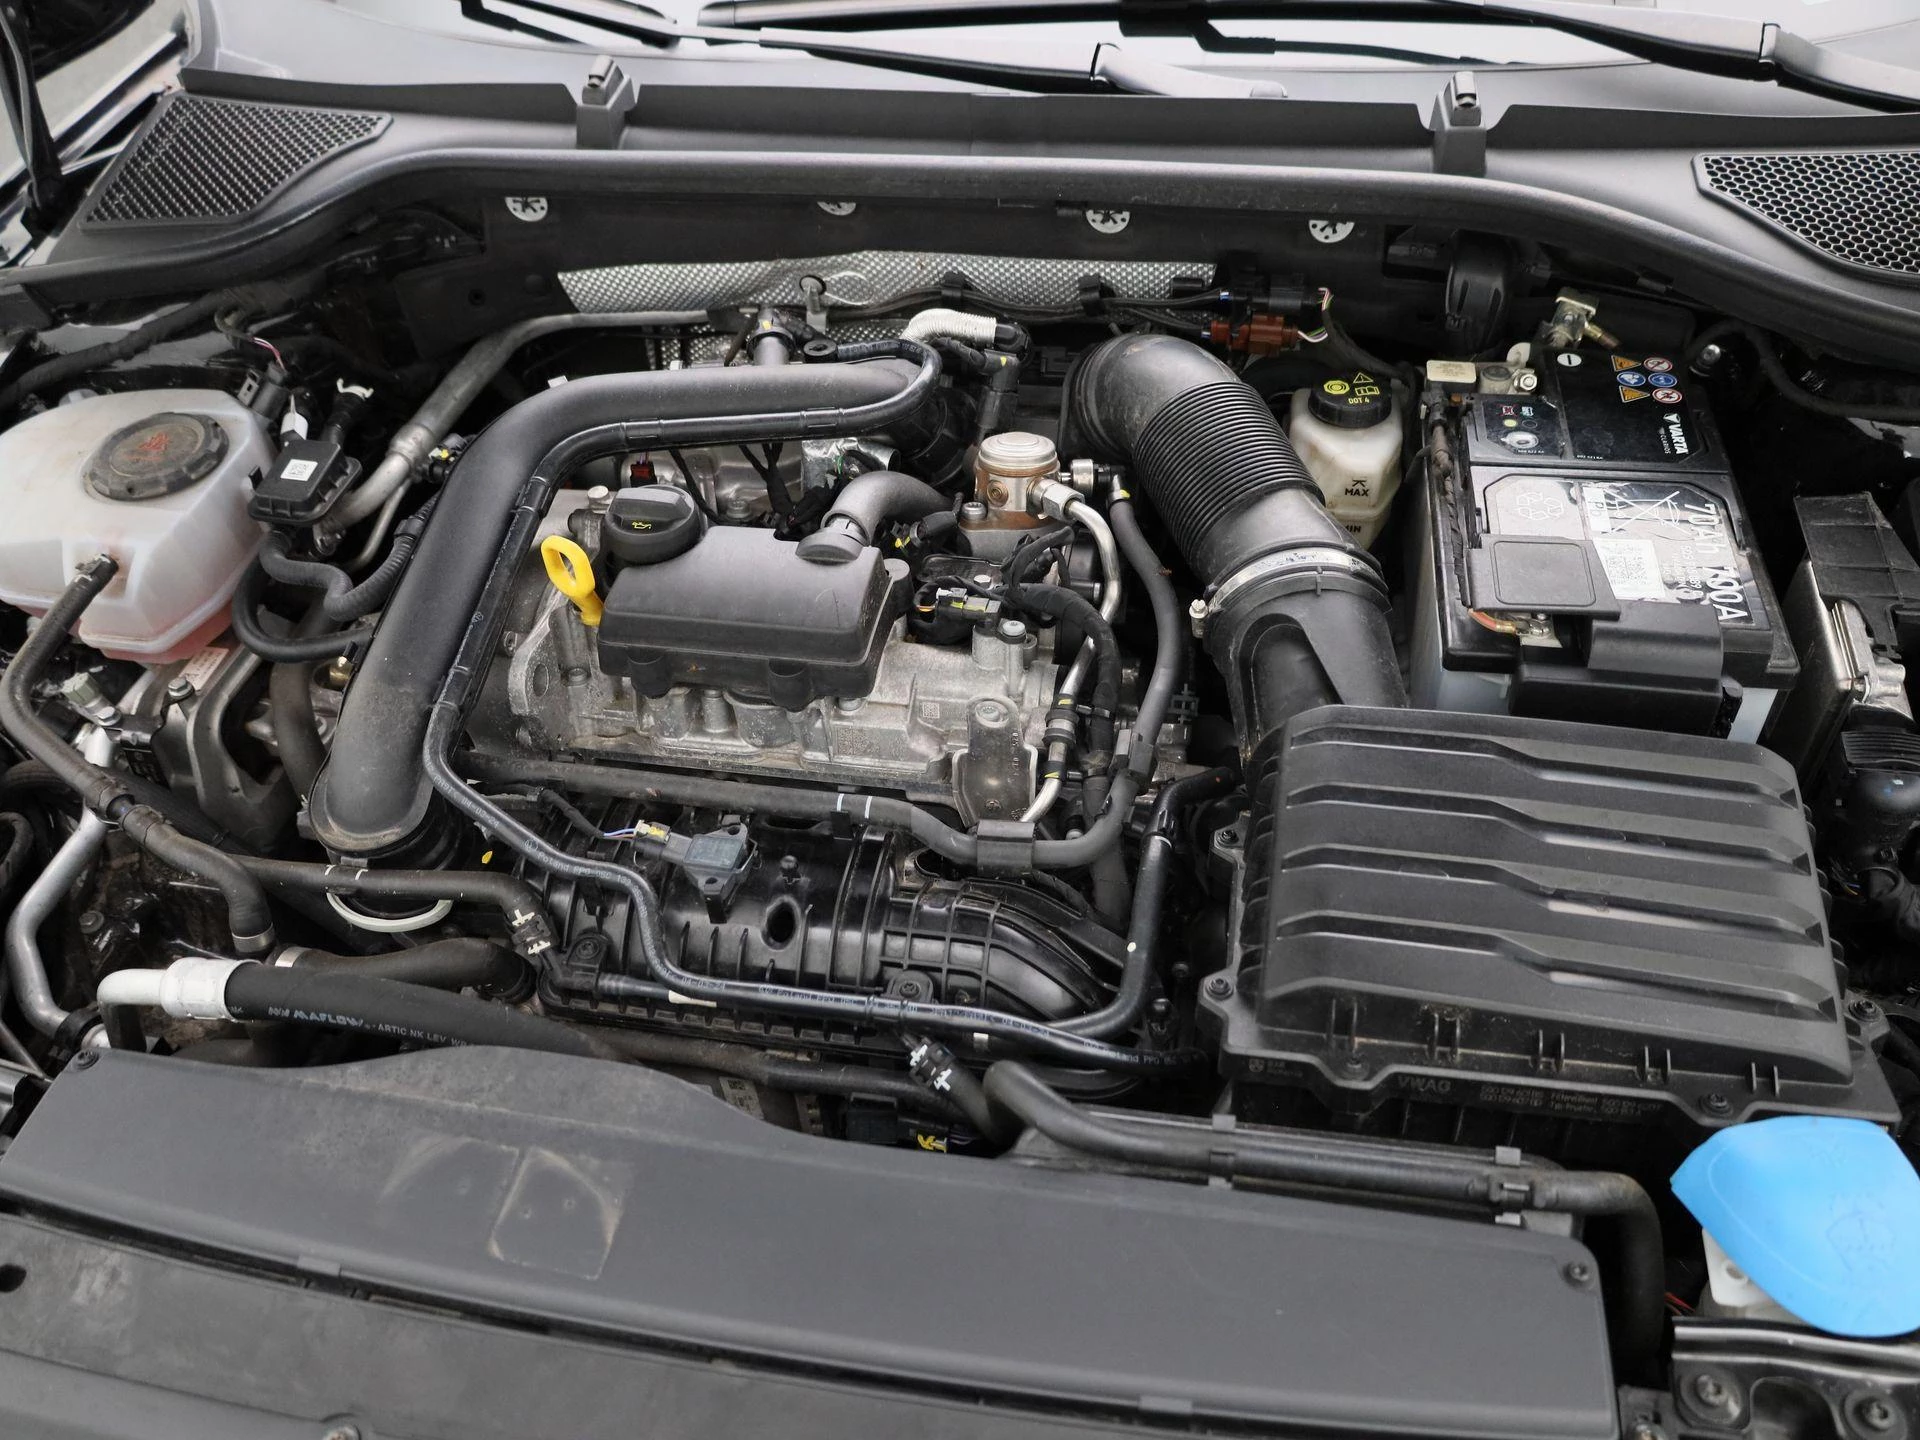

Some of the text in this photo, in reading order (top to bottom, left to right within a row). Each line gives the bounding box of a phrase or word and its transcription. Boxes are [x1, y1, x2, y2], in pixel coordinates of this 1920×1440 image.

[1669, 423, 1689, 454] VARTA
[1344, 488, 1370, 497] MAX
[538, 851, 570, 873] Poland
[293, 1009, 364, 1028] MAFLOW
[377, 1023, 407, 1036] ARTIC
[410, 1029, 424, 1039] NK
[427, 1032, 447, 1043] LEV
